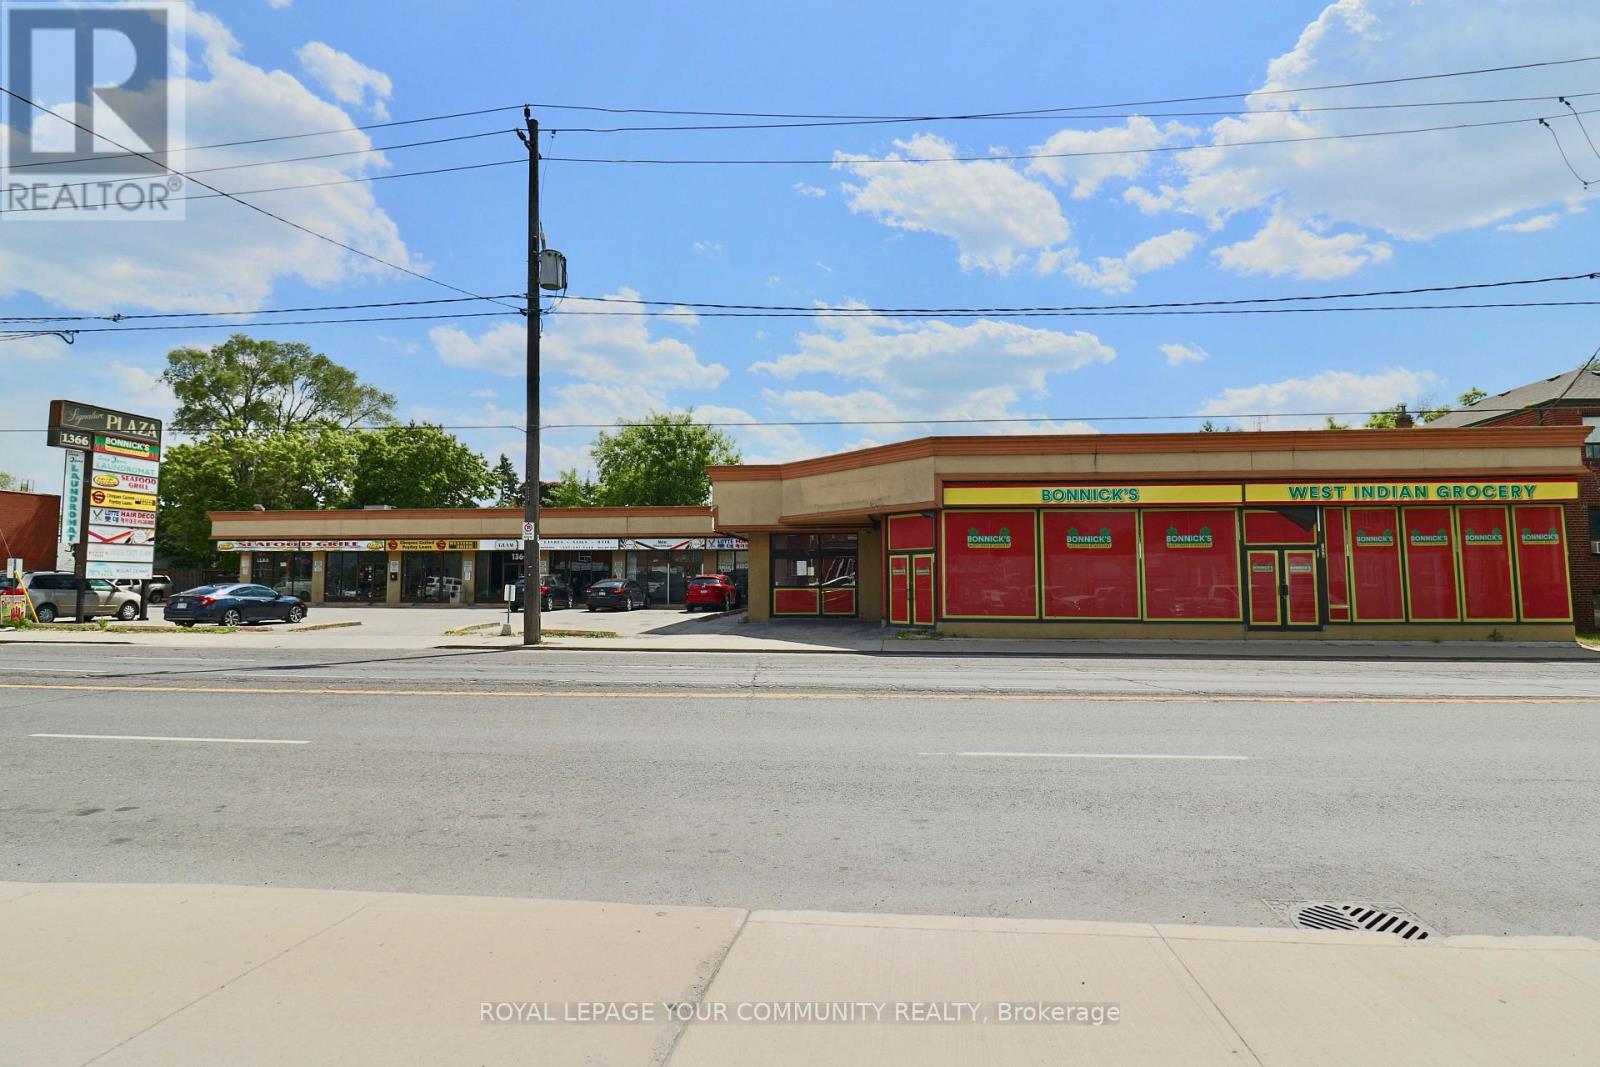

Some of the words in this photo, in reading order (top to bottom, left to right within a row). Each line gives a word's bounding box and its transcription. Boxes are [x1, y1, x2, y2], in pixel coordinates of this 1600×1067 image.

[106, 414, 157, 438] PLAZA
[61, 433, 88, 446] 1366
[105, 437, 150, 451] BONNICK'S
[96, 462, 155, 475] LAUNDROMAT
[121, 475, 157, 485] SEAFOOD
[128, 482, 149, 490] GRILL
[1042, 488, 1140, 502] BONNICK'S
[1288, 485, 1347, 500] WEST
[1353, 485, 1429, 500] INDIAN
[1436, 484, 1538, 500] GROCERY
[67, 464, 80, 541] LAUNDROMAT
[104, 509, 119, 517] LOTTE
[967, 535, 1011, 543] BONNICK'S
[1067, 535, 1112, 543] BONNICK'S
[1166, 534, 1212, 542] BONNICK'S
[512, 553, 525, 561] 136
